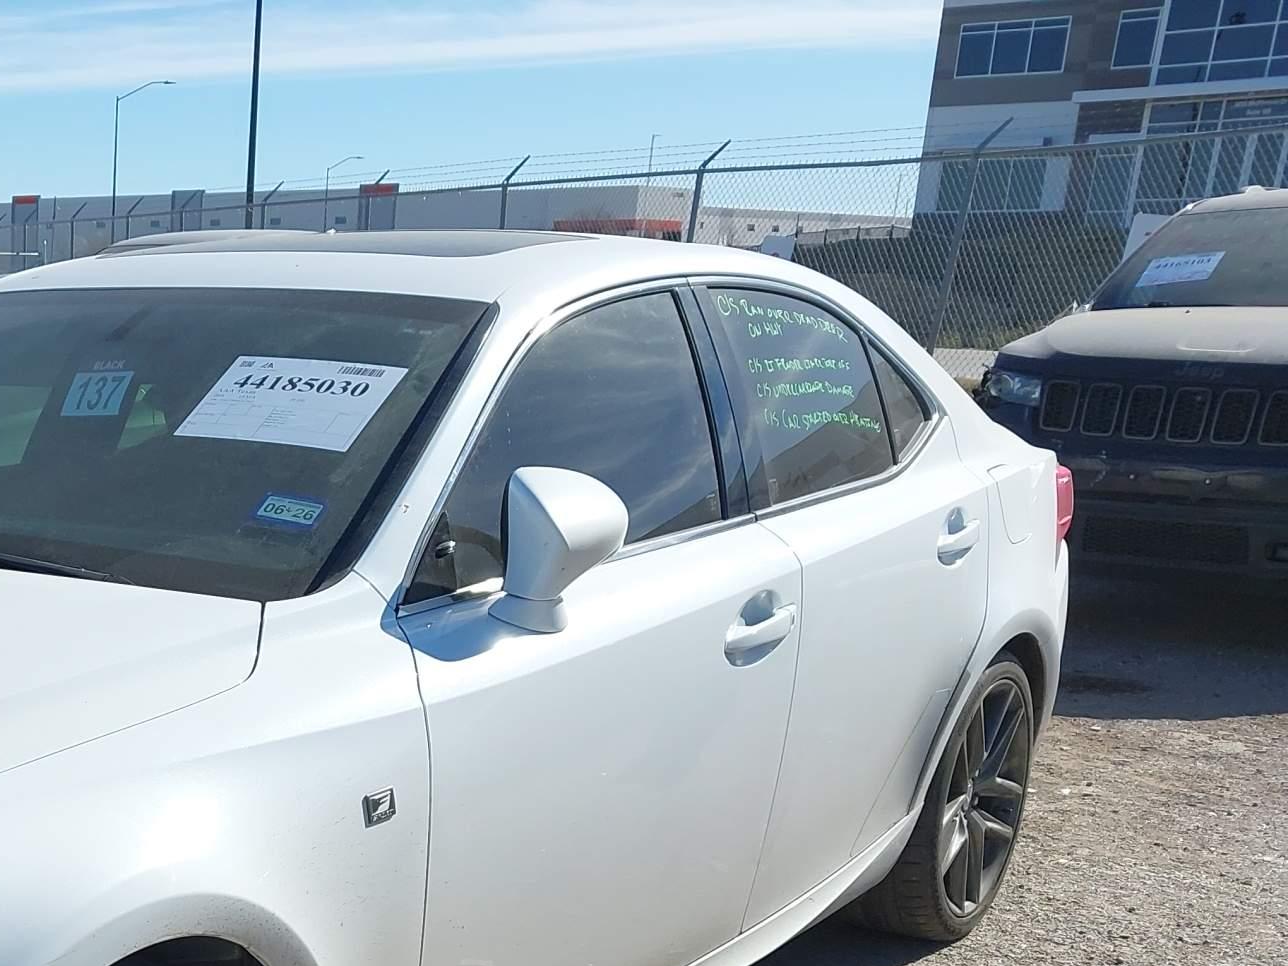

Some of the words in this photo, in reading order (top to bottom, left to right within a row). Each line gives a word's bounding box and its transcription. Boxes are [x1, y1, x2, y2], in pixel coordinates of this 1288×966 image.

[94, 360, 126, 370] BLACK
[75, 375, 128, 410] 137
[233, 374, 370, 397] 44185030
